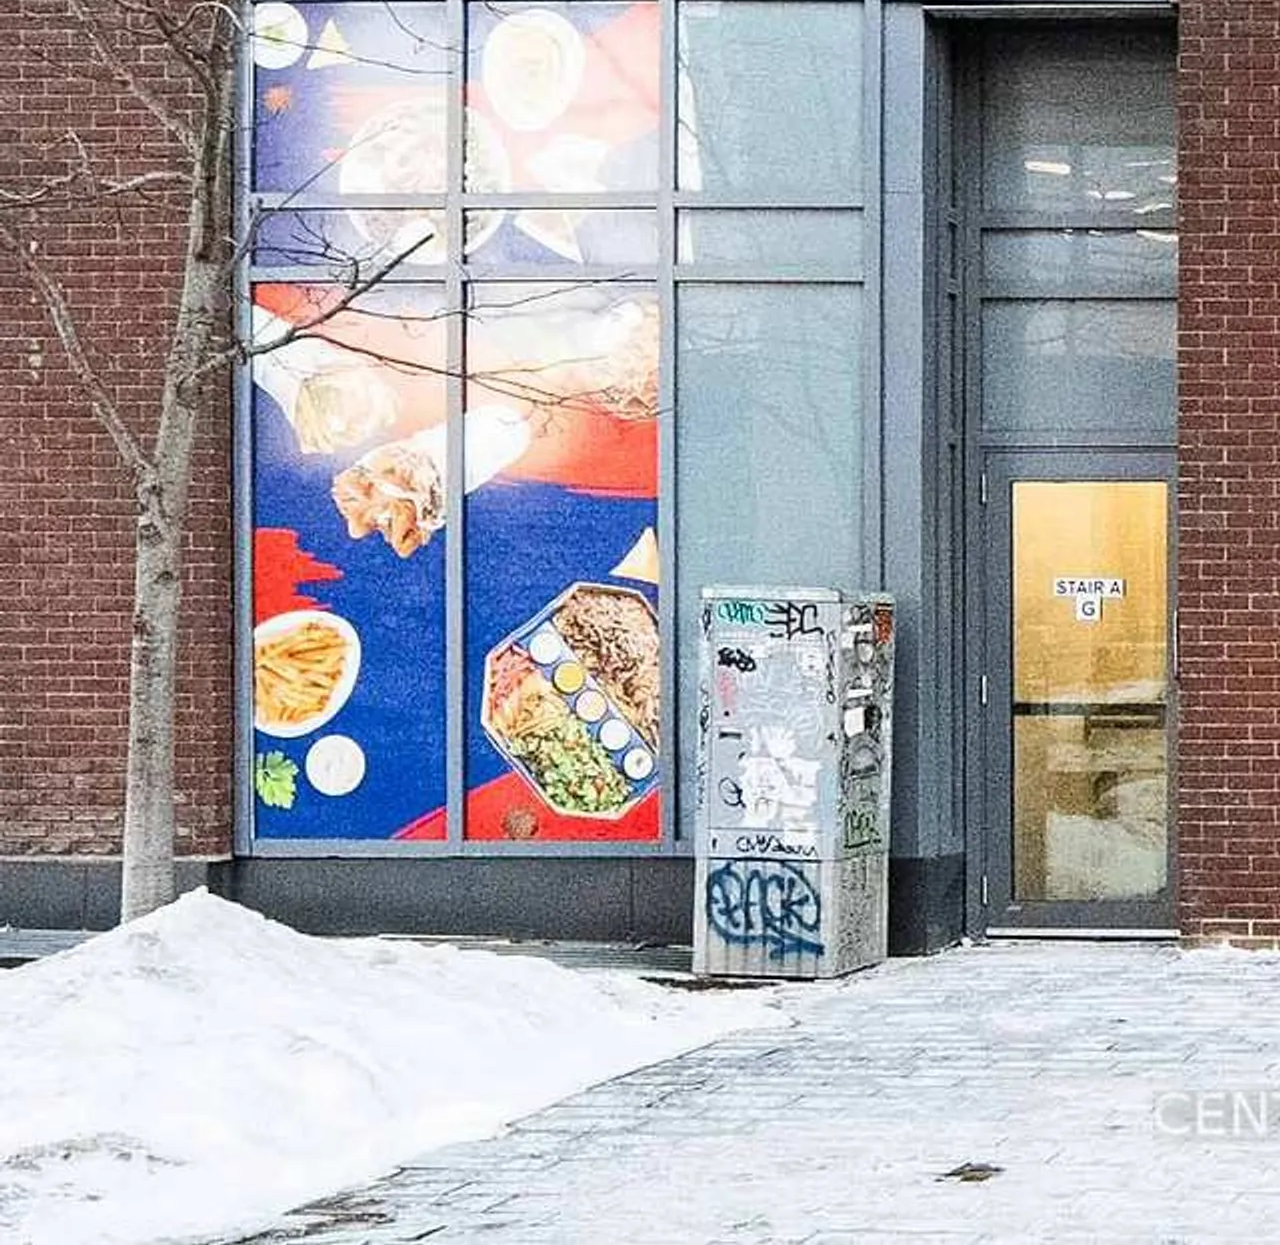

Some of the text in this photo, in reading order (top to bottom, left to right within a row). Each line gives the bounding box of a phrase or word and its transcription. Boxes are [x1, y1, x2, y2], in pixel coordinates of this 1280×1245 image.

[1055, 580, 1121, 595] STAIR A
[1081, 600, 1096, 617] G
